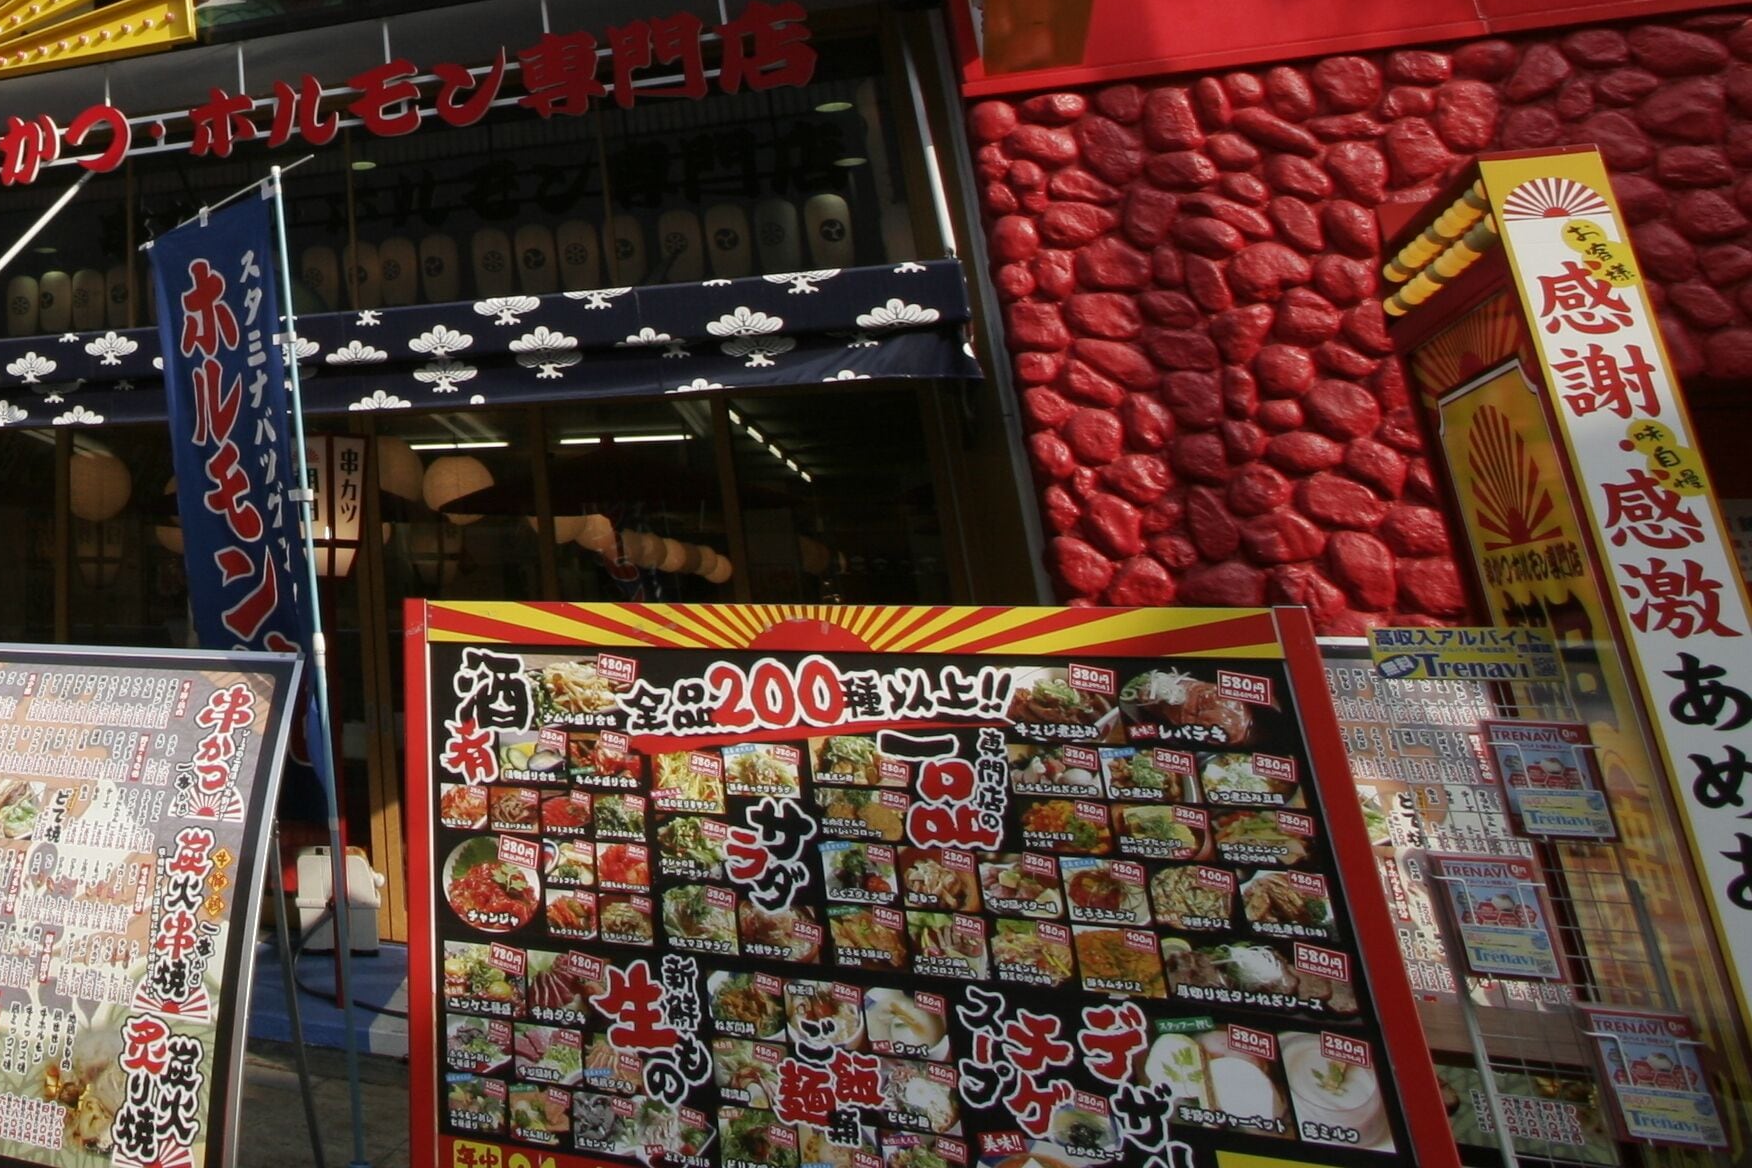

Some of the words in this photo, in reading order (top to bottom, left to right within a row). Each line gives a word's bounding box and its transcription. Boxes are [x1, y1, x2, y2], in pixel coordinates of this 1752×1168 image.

[339, 447, 359, 524] 串カツ
[1373, 628, 1542, 647] 高収入アルバイト
[1072, 666, 1110, 685] 380円
[1416, 652, 1530, 679] Trenavi
[1220, 674, 1266, 695] 580円
[195, 685, 256, 796] 串かつ
[1491, 729, 1560, 744] TRENAVI
[976, 726, 1009, 831] 専門店の
[1443, 864, 1508, 880] TRENAVI
[1297, 945, 1343, 970] 580円
[1231, 1027, 1272, 1048] 380円
[1594, 1018, 1666, 1036] TRENAVI
[1324, 1033, 1366, 1055] 280円
